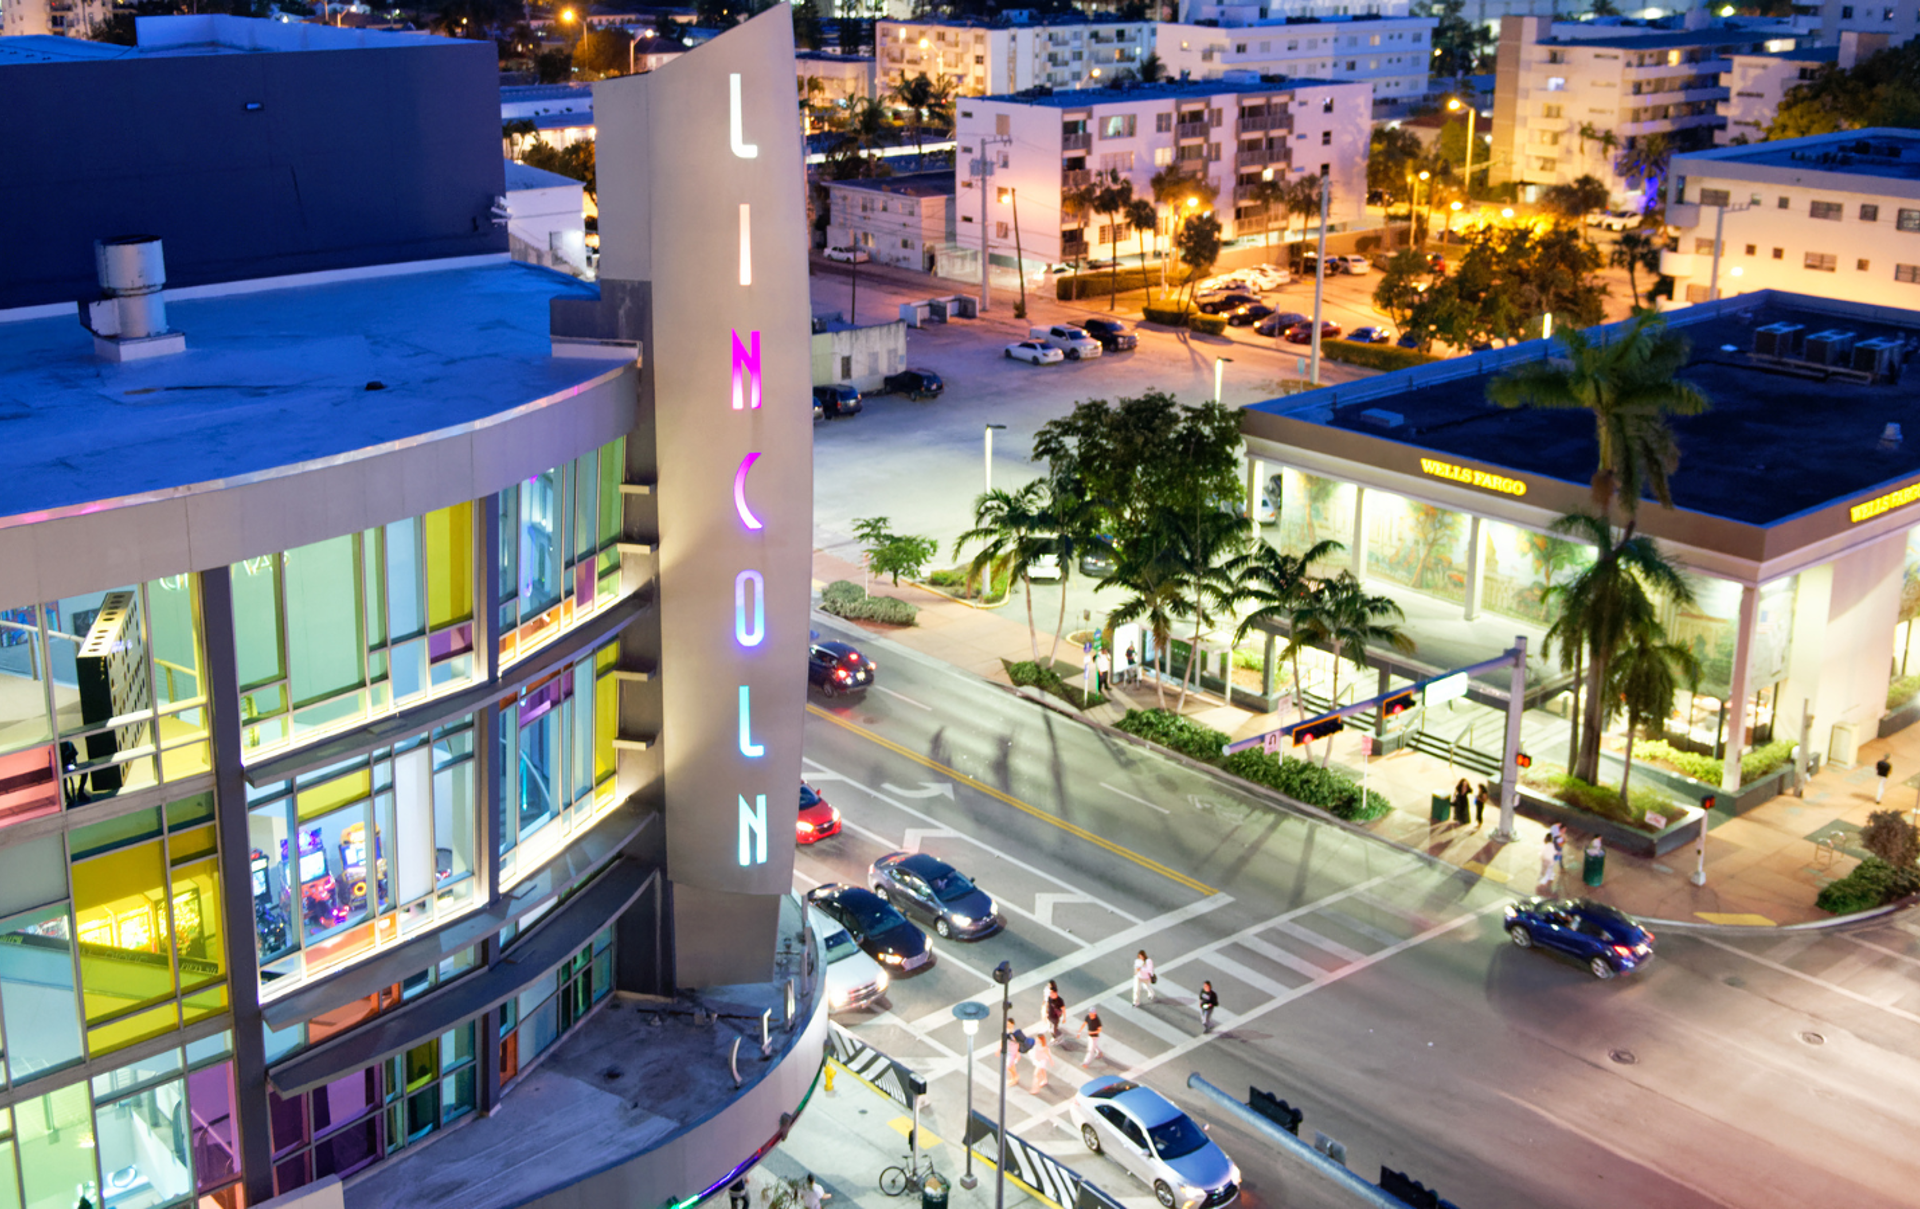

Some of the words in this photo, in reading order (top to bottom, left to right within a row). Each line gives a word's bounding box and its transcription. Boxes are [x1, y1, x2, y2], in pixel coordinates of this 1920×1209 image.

[730, 73, 768, 867] LINCOLN
[1420, 457, 1473, 484] WELLS
[1472, 469, 1527, 497] FARGO
[1849, 494, 1890, 523] WELLS
[1889, 482, 1920, 508] FARG
